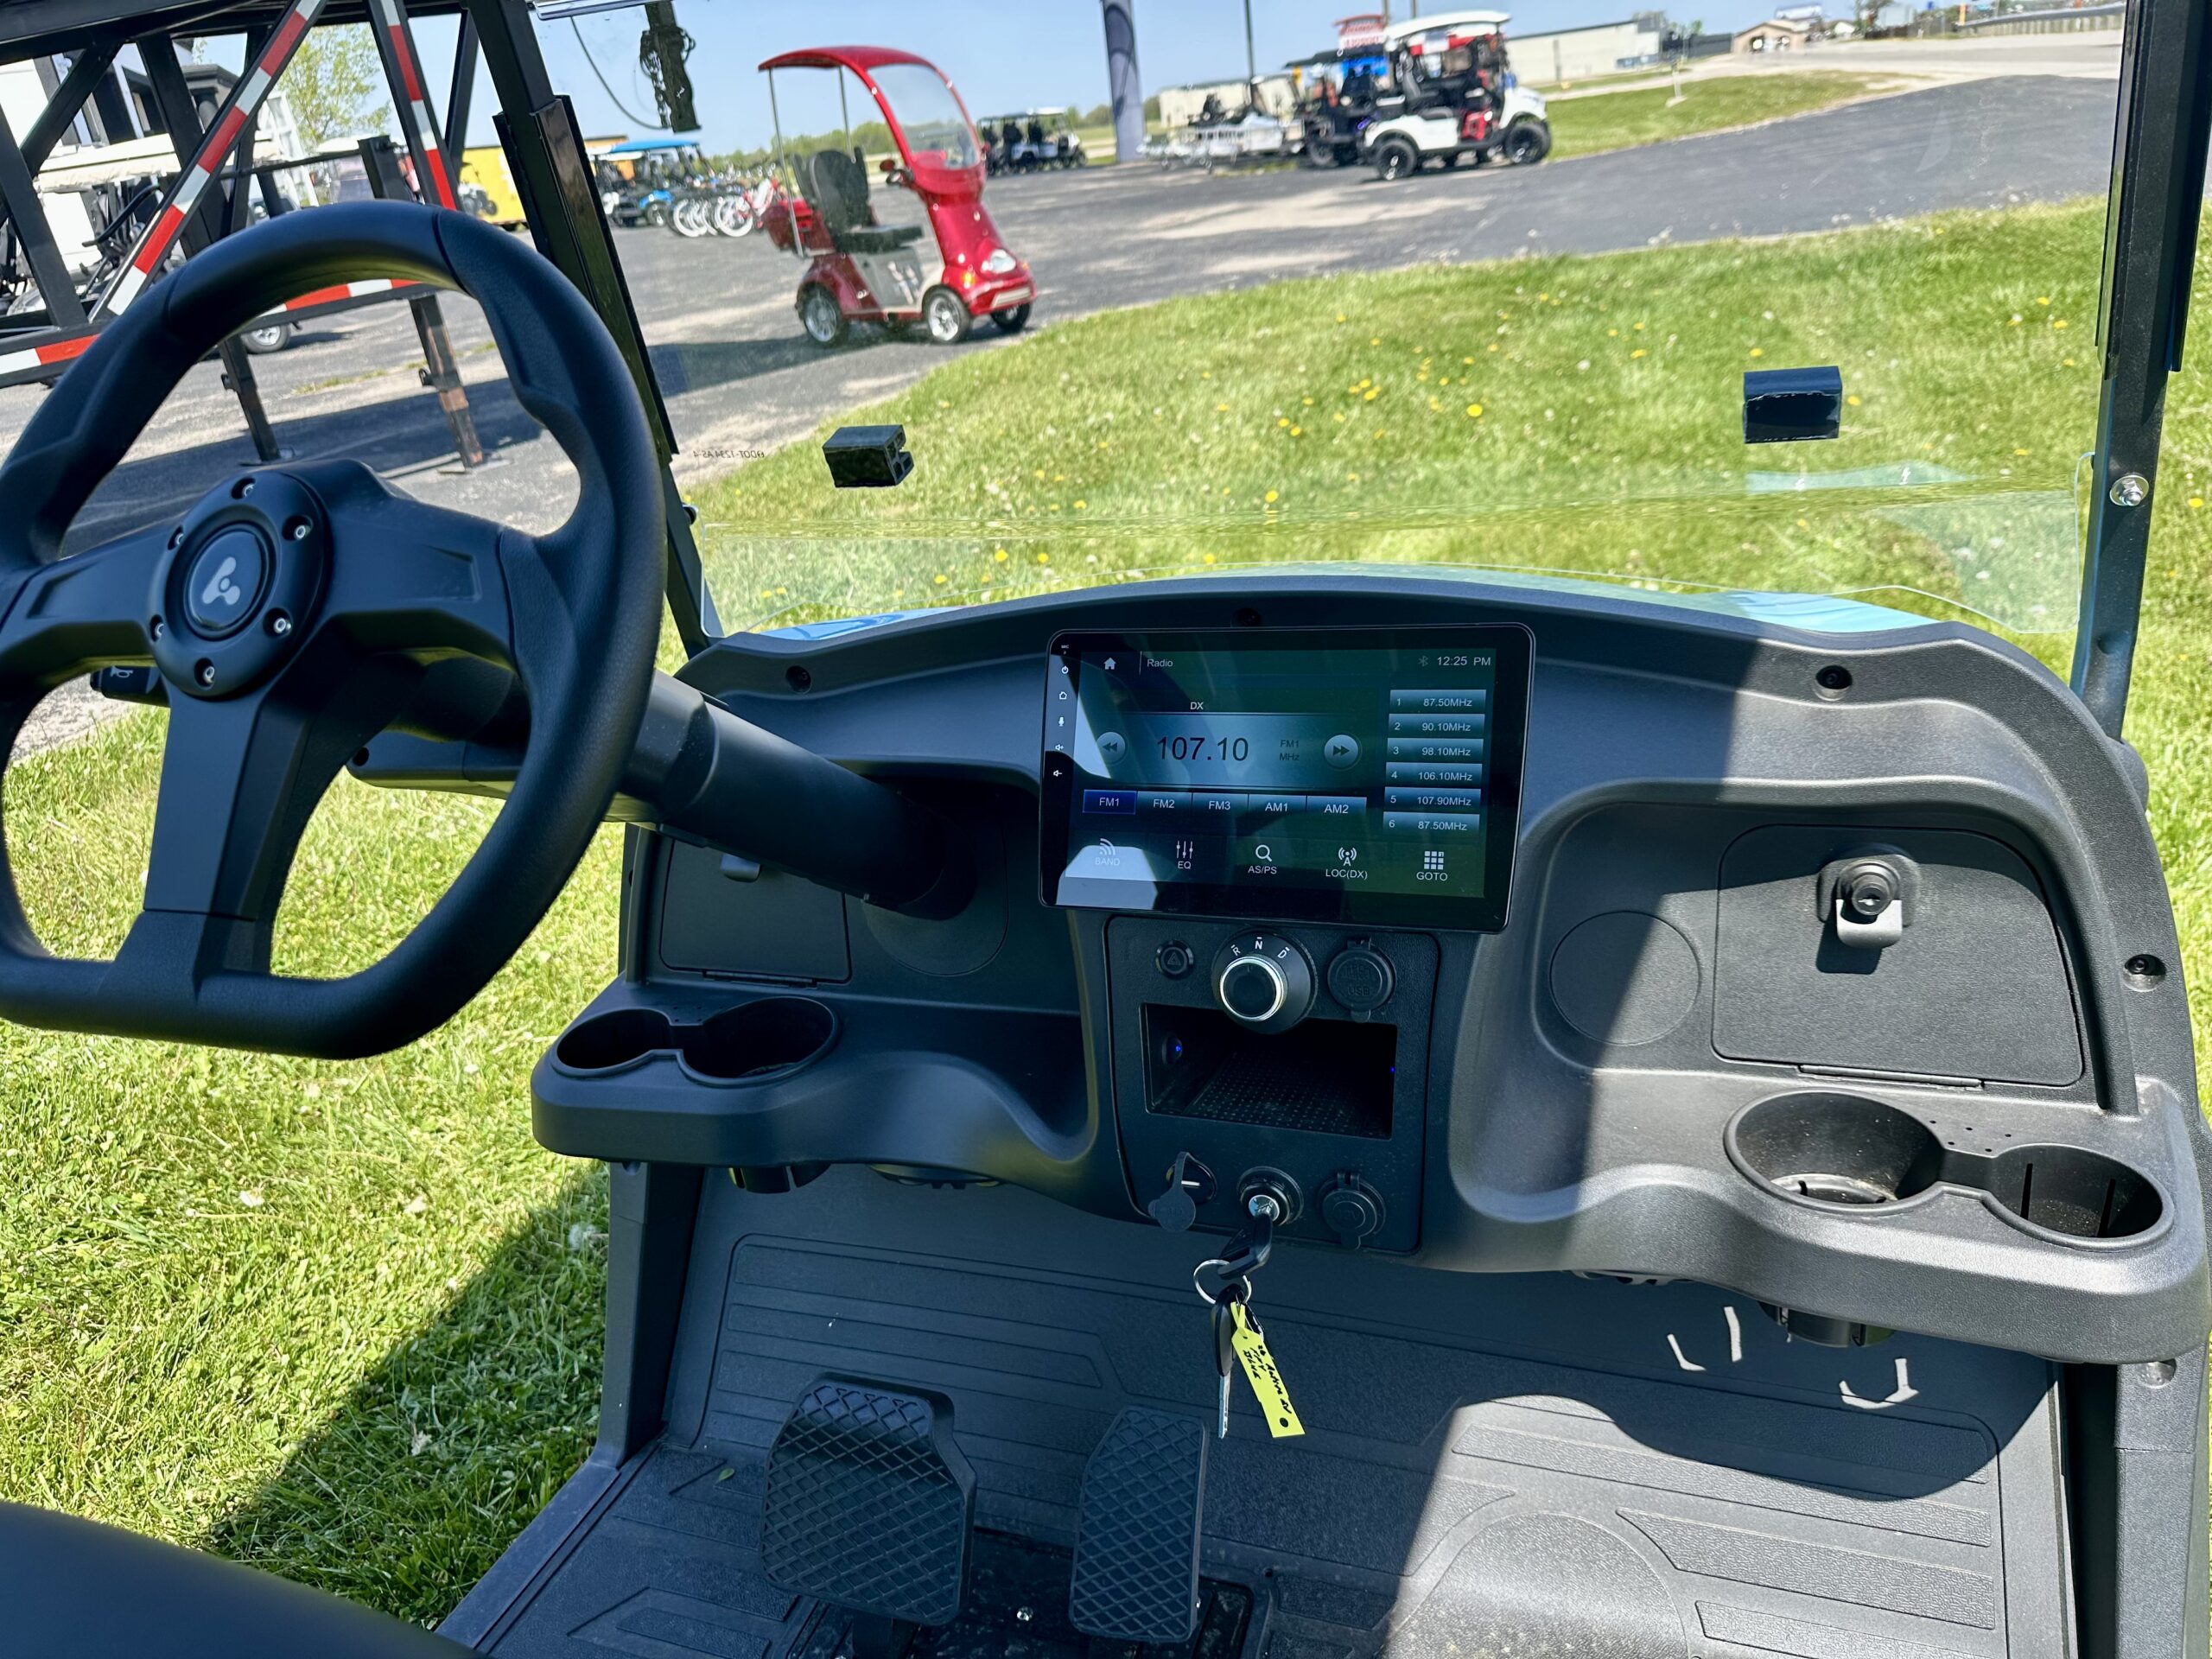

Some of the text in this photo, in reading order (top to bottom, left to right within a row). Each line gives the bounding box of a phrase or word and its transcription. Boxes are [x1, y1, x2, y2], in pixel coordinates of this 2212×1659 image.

[1147, 658, 1173, 667] Radio
[1437, 656, 1491, 666] 12:25 PM
[1190, 702, 1204, 710] DX
[1423, 698, 1472, 707] 87.50MHz
[1394, 721, 1471, 732] 2 90.10MHz
[1157, 736, 1249, 761] 107.10
[1421, 747, 1471, 756] 98.10MHz
[1279, 753, 1300, 761] MHz
[1391, 771, 1473, 781] 4 106.10MHz
[1099, 798, 1120, 807] FM1
[1153, 798, 1175, 809] FM2
[1208, 800, 1231, 810] FM3
[1389, 795, 1471, 806] 5 107.90MHz
[1265, 802, 1288, 812] AM1
[1324, 804, 1350, 814] AM2
[1389, 819, 1468, 830] 6 87.50MHz
[1095, 856, 1121, 866] BAND
[1177, 861, 1192, 870] EQ
[1247, 865, 1278, 874] AS/PS
[1325, 869, 1368, 880] LOC(DX)
[1416, 872, 1448, 881] GOTO
[1232, 940, 1287, 958] R N D
[1348, 985, 1370, 995] USB
